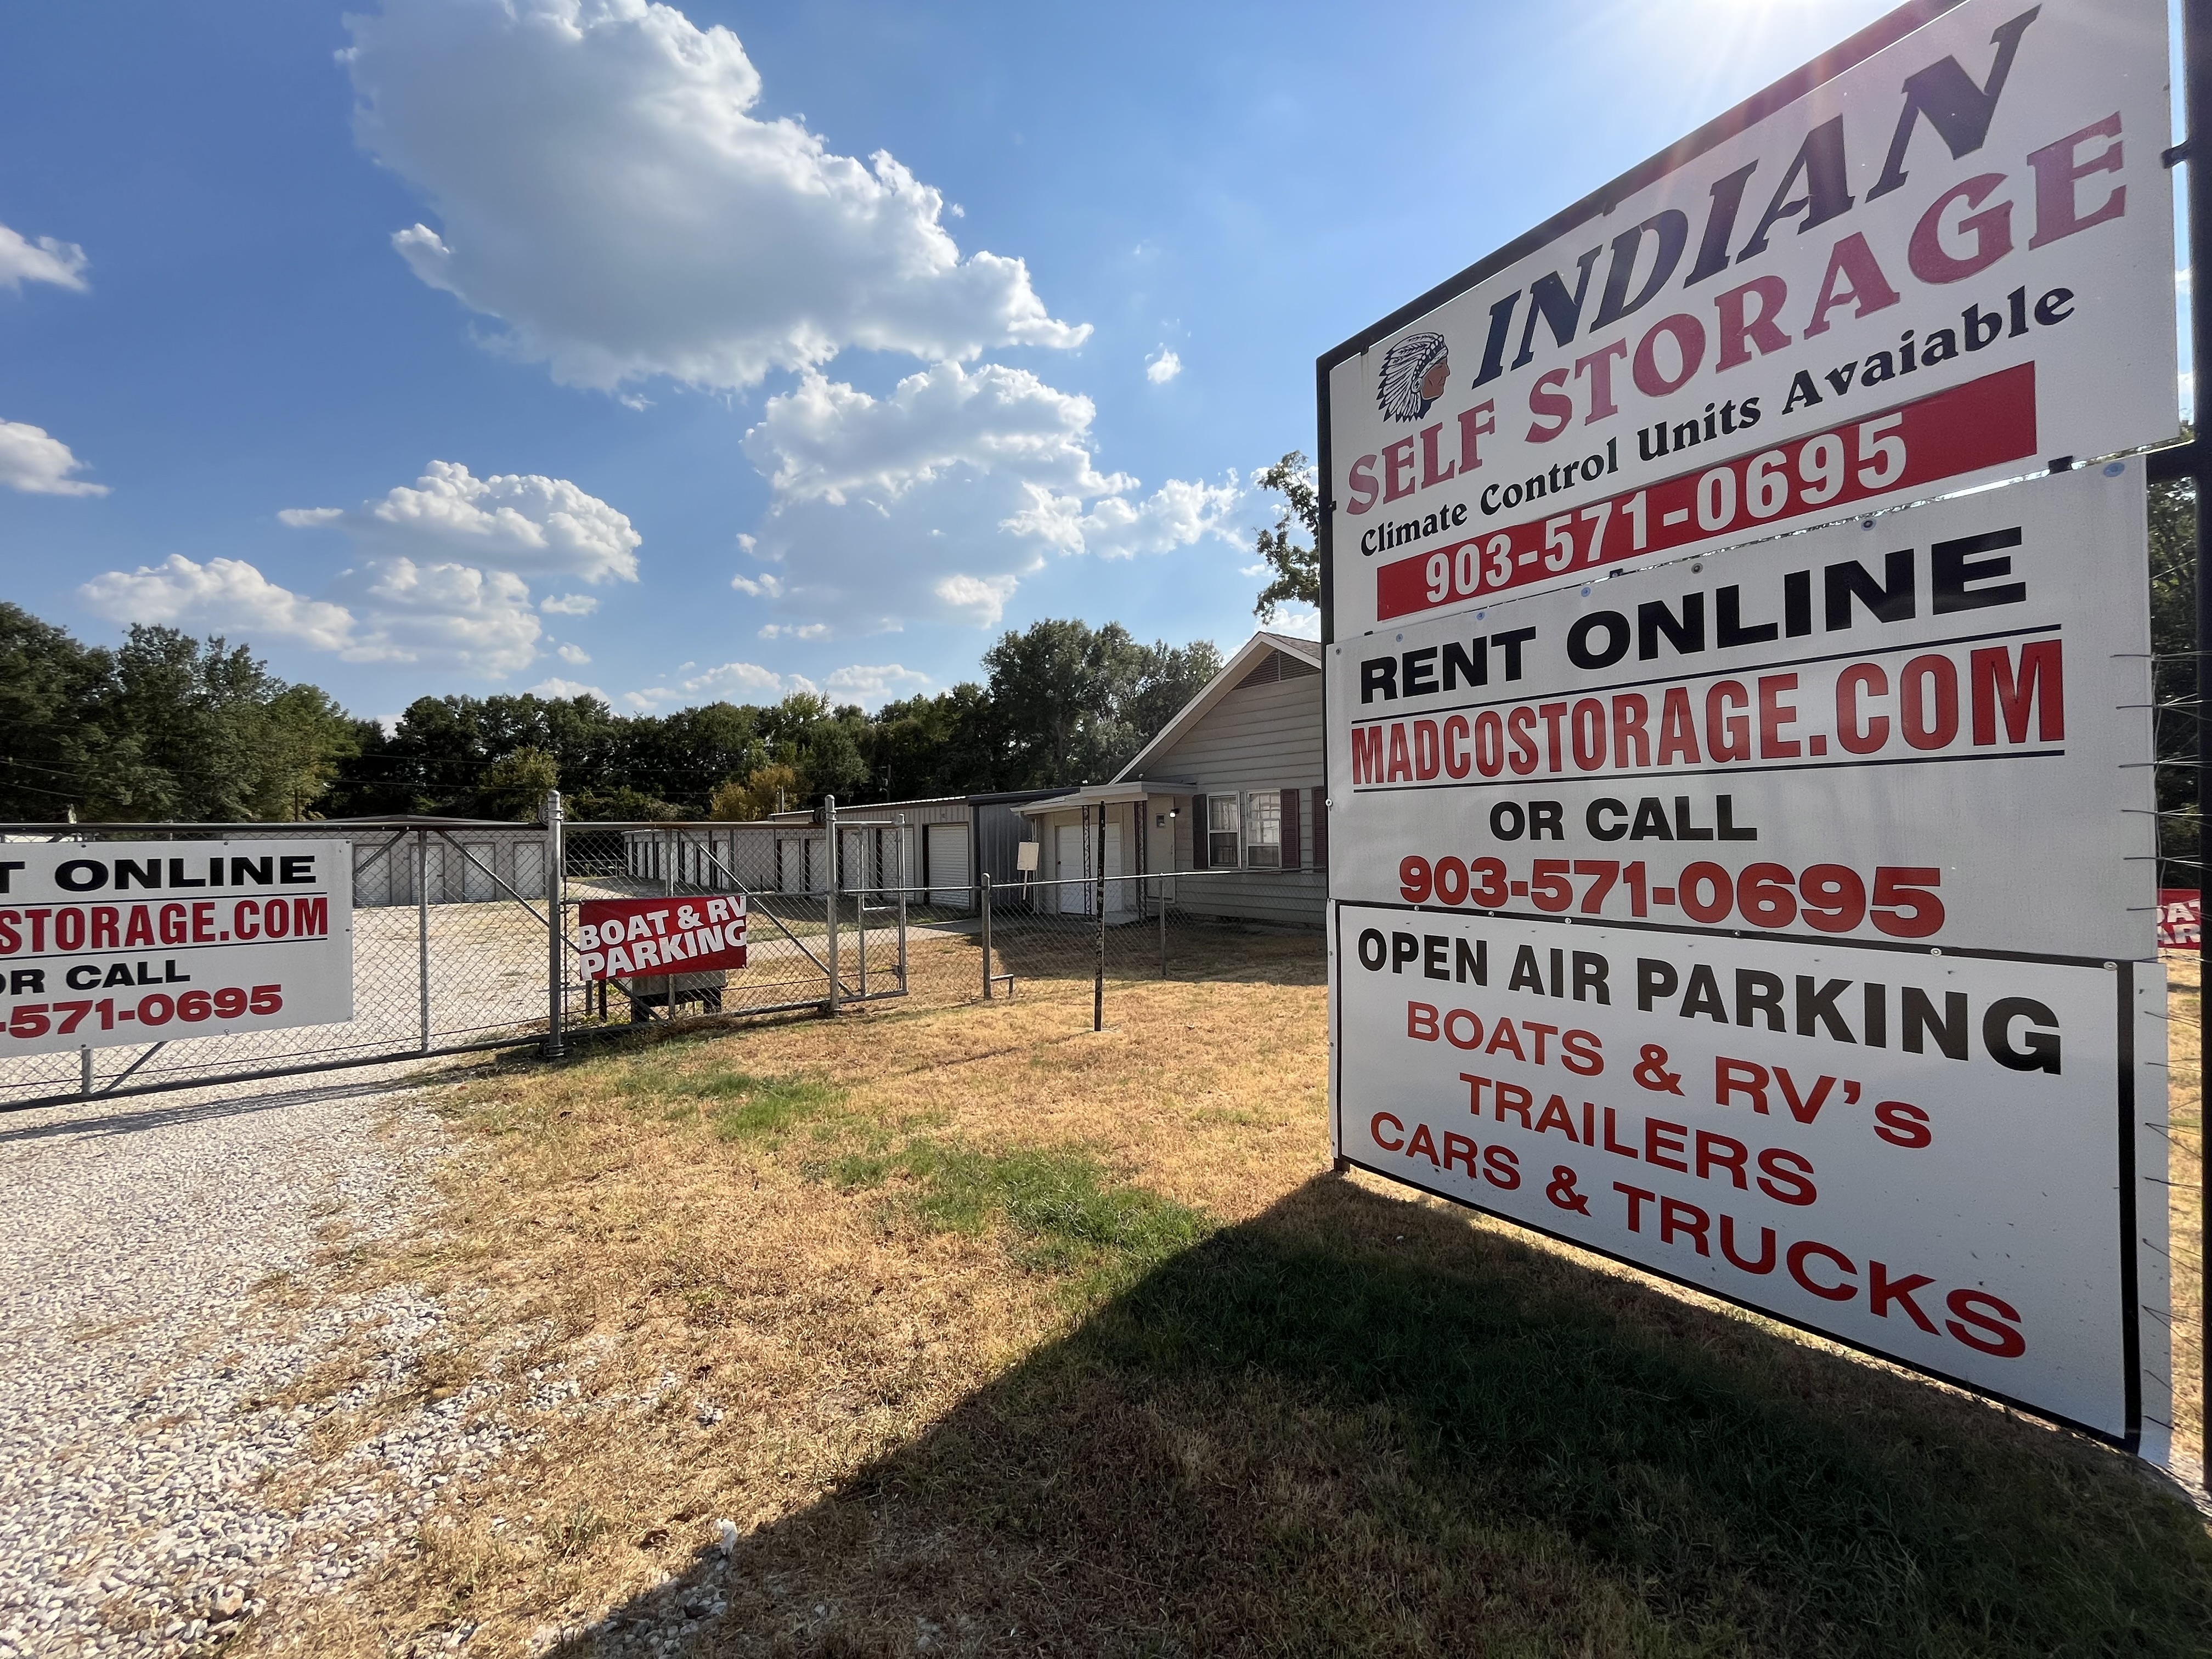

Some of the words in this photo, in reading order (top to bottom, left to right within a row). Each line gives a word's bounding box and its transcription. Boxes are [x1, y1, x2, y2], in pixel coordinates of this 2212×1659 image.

[1472, 4, 2042, 390] INDIAN
[1346, 398, 1495, 515] SELF
[1525, 111, 2126, 444] STORAGE
[1361, 503, 1468, 557] Climate
[1481, 437, 1618, 515] Control
[1638, 397, 1762, 461] Units
[1782, 285, 2075, 415] Avaiable
[1426, 412, 1906, 603] 903-571-0695
[1361, 626, 1536, 705] RENT
[1566, 526, 2027, 670] ONLINE
[1351, 640, 2064, 785] MADCOSTORAGE.COM
[55, 855, 317, 892] ONLINE
[1489, 801, 1564, 842] OR
[1586, 794, 1757, 842] CALL
[0, 898, 328, 954] STORAGE.COM
[579, 910, 669, 951] BOAT
[678, 905, 703, 929] &
[707, 896, 746, 923] RV
[580, 920, 746, 981] PARKING
[1398, 855, 1945, 938] 903-571-0695
[0, 969, 45, 995] R
[66, 960, 191, 990] CALL
[1357, 927, 1488, 988] OPEN
[1508, 946, 1611, 1006] AIR
[1638, 957, 2063, 1075] PARKING
[1408, 1000, 1603, 1077] BOATS
[1632, 1043, 1686, 1096] &
[1459, 1072, 1817, 1206] TRAILERS
[1370, 1111, 1520, 1190] CARS
[1545, 1165, 1592, 1216] &
[1612, 1181, 2027, 1358] TRUCKS
